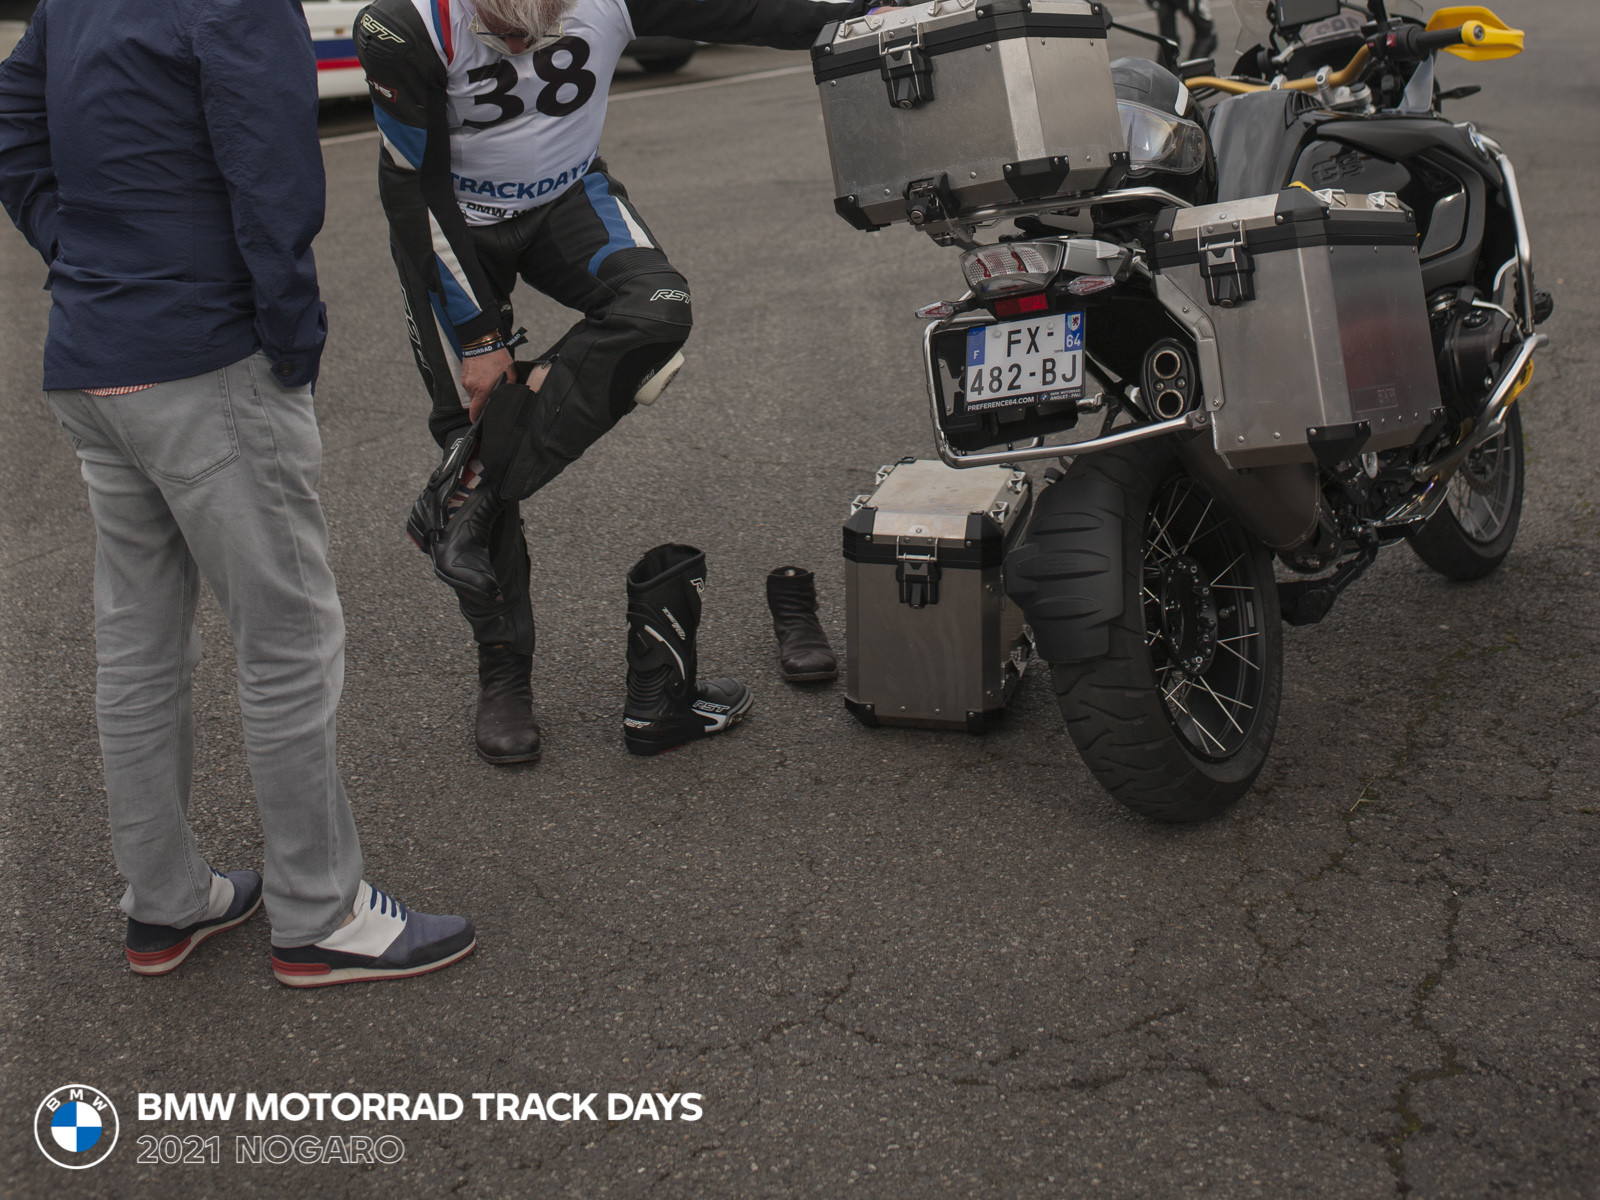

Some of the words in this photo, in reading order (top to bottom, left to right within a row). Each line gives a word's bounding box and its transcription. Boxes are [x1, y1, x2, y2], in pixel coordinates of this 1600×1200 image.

[360, 13, 406, 44] RST
[461, 34, 598, 131] 38
[1066, 332, 1082, 348] 64
[972, 349, 981, 360] F
[970, 354, 1078, 396] 482-BJ
[967, 396, 1035, 411] PREFERENCE64.COM
[691, 700, 731, 714] RST
[622, 718, 651, 730] RST
